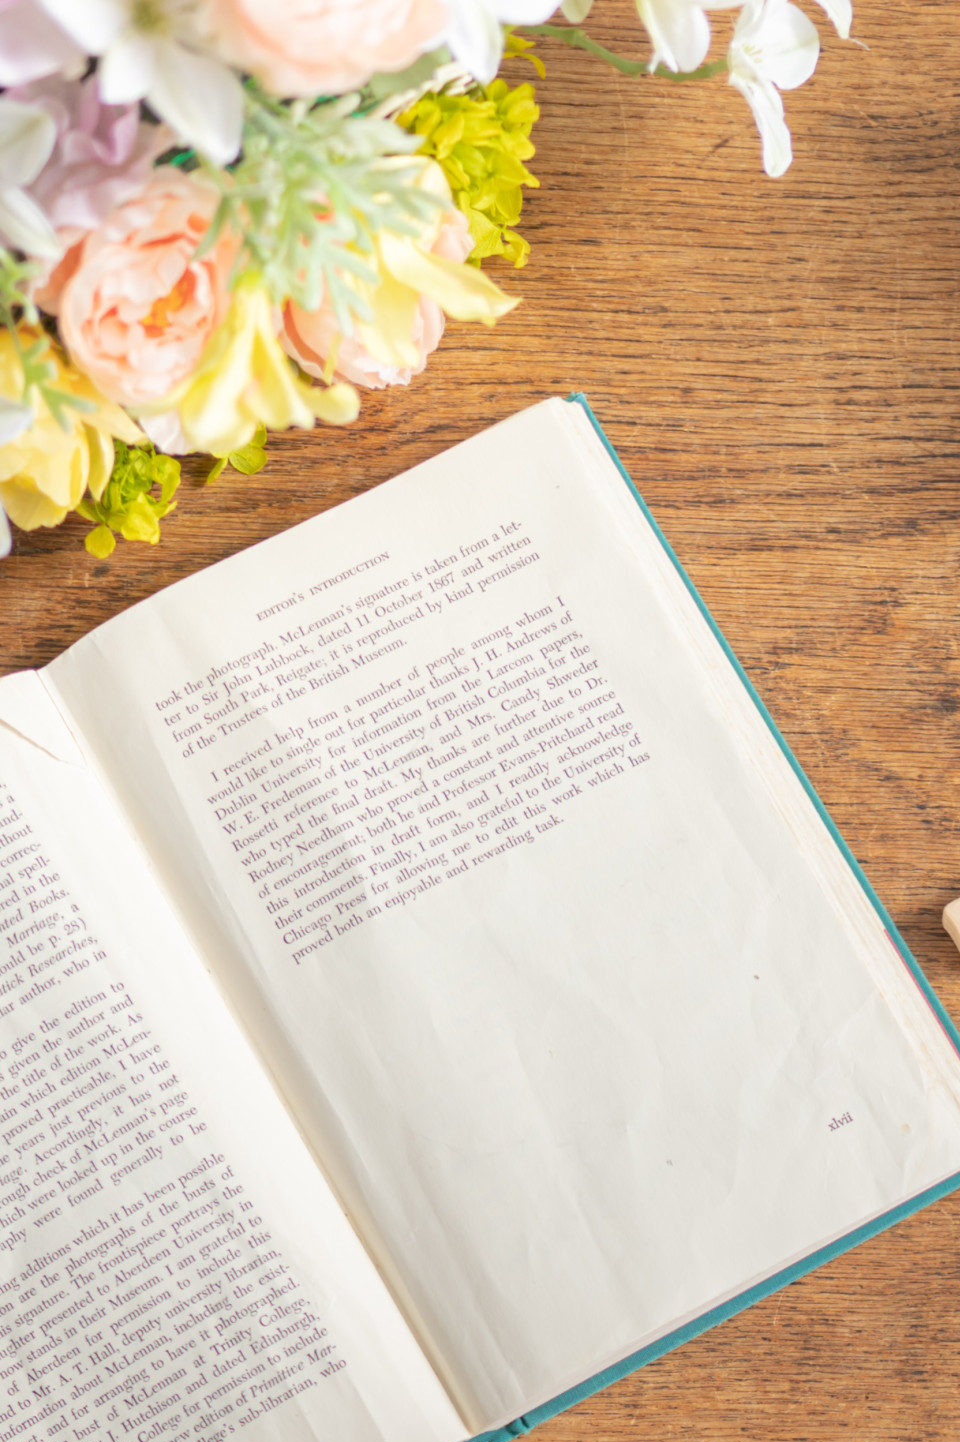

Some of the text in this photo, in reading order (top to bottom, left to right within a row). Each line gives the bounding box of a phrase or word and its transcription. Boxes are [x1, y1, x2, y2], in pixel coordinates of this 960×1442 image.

[155, 521, 521, 711] took the photograph. McLennan's signature is taken from a let-
[164, 537, 531, 726] ter to Sir John Lubbock, dated 11 October 1867 and written
[172, 552, 539, 742] from South Park, Reigate; it is reproduced by kind permission
[256, 552, 389, 621] EDITOR'S INTRODUCTION
[182, 640, 407, 758] of the Trustees of the British Museum.
[207, 610, 573, 804] would like to single out for particular thanks J. H. Andrews of
[210, 595, 565, 782] I received help from a number of people among whom I
[214, 631, 582, 821] Dublin University for information from the Larcom papers,
[222, 645, 590, 834] W. E. Fredeman of the University of British Columbia for the
[6, 904, 79, 948] Marriage, a
[291, 814, 564, 964] proved both an enjoyable and rewarding task.
[0, 1013, 142, 1100] the title of the work. As
[0, 1044, 161, 1145] proved practicable, I have
[828, 1112, 853, 1131] xlvii
[0, 1264, 289, 1442] information about McLennan, including the exist-
[7, 1232, 271, 1396] of Aberdeen for permission to include this
[72, 1419, 101, 1440] bust
[107, 1405, 119, 1421] of
[123, 1368, 187, 1410] McLennan
[193, 1355, 206, 1368] at
[209, 1328, 252, 1356] Trinity
[259, 1298, 310, 1326] College,
[137, 1414, 181, 1442] College
[182, 1402, 200, 1417] for
[203, 1364, 266, 1408] permission
[267, 1355, 281, 1366] to
[282, 1327, 327, 1357] include
[238, 1379, 317, 1426] sub-librarian,
[320, 1360, 346, 1377] who
